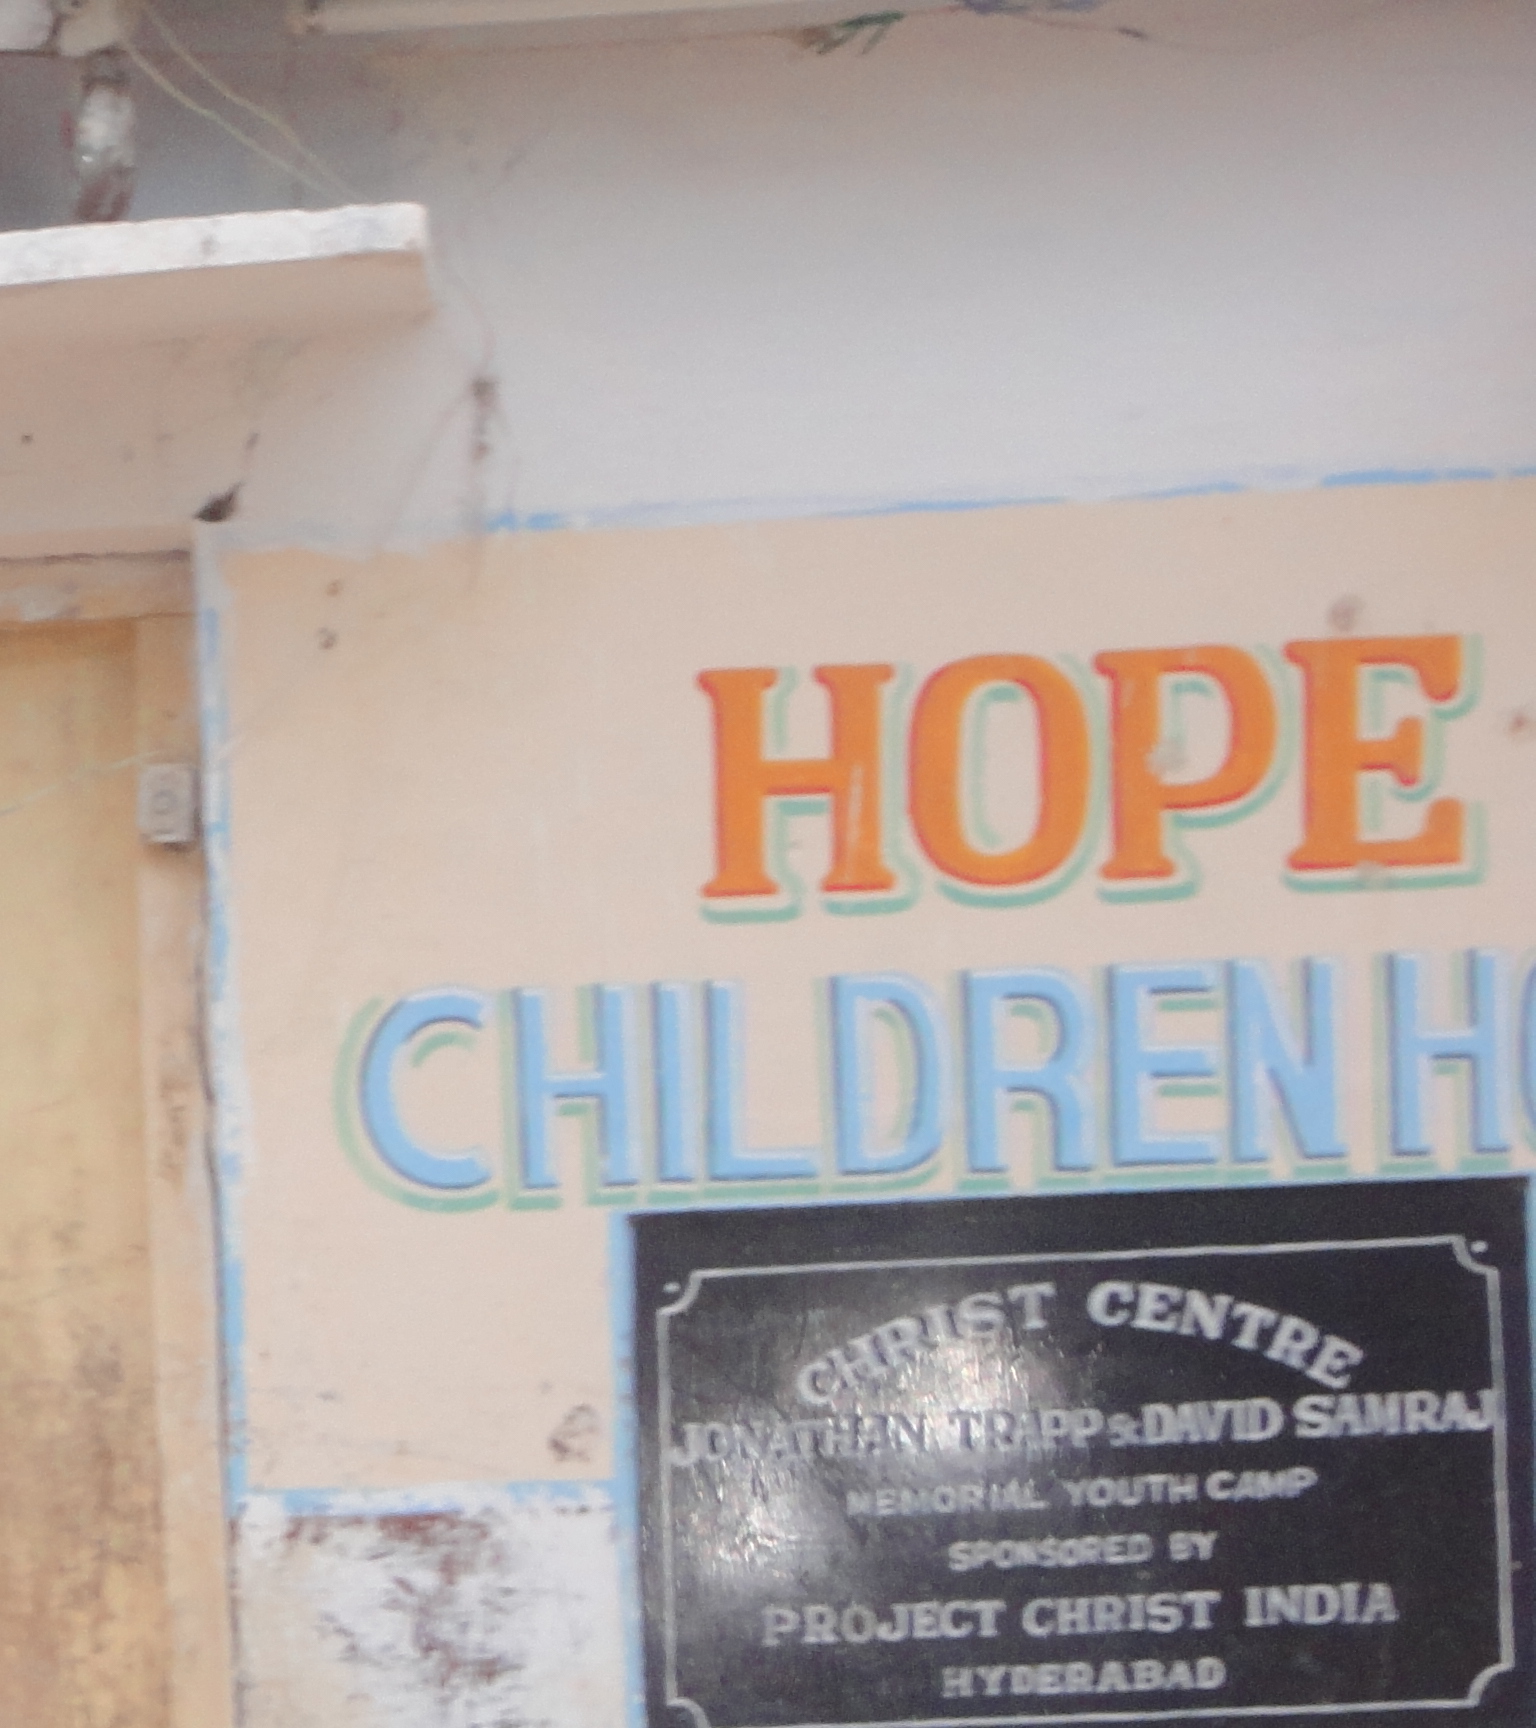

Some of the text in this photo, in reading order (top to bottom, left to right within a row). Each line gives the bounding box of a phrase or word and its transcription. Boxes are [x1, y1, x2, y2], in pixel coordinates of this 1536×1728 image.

[696, 634, 1465, 900] HOPE
[359, 948, 1536, 1192] CHILDREN H
[795, 1280, 1364, 1406] CHRIST CENTRE
[1292, 1388, 1500, 1440] SAMRAJ
[845, 1465, 1319, 1517] MEMORIAL YOUTH CAMP
[947, 1531, 1220, 1573] SPONSORED BY
[760, 1582, 1400, 1648] PROJECT CHRIST INDIA
[941, 1656, 1227, 1700] HYDERABAD
